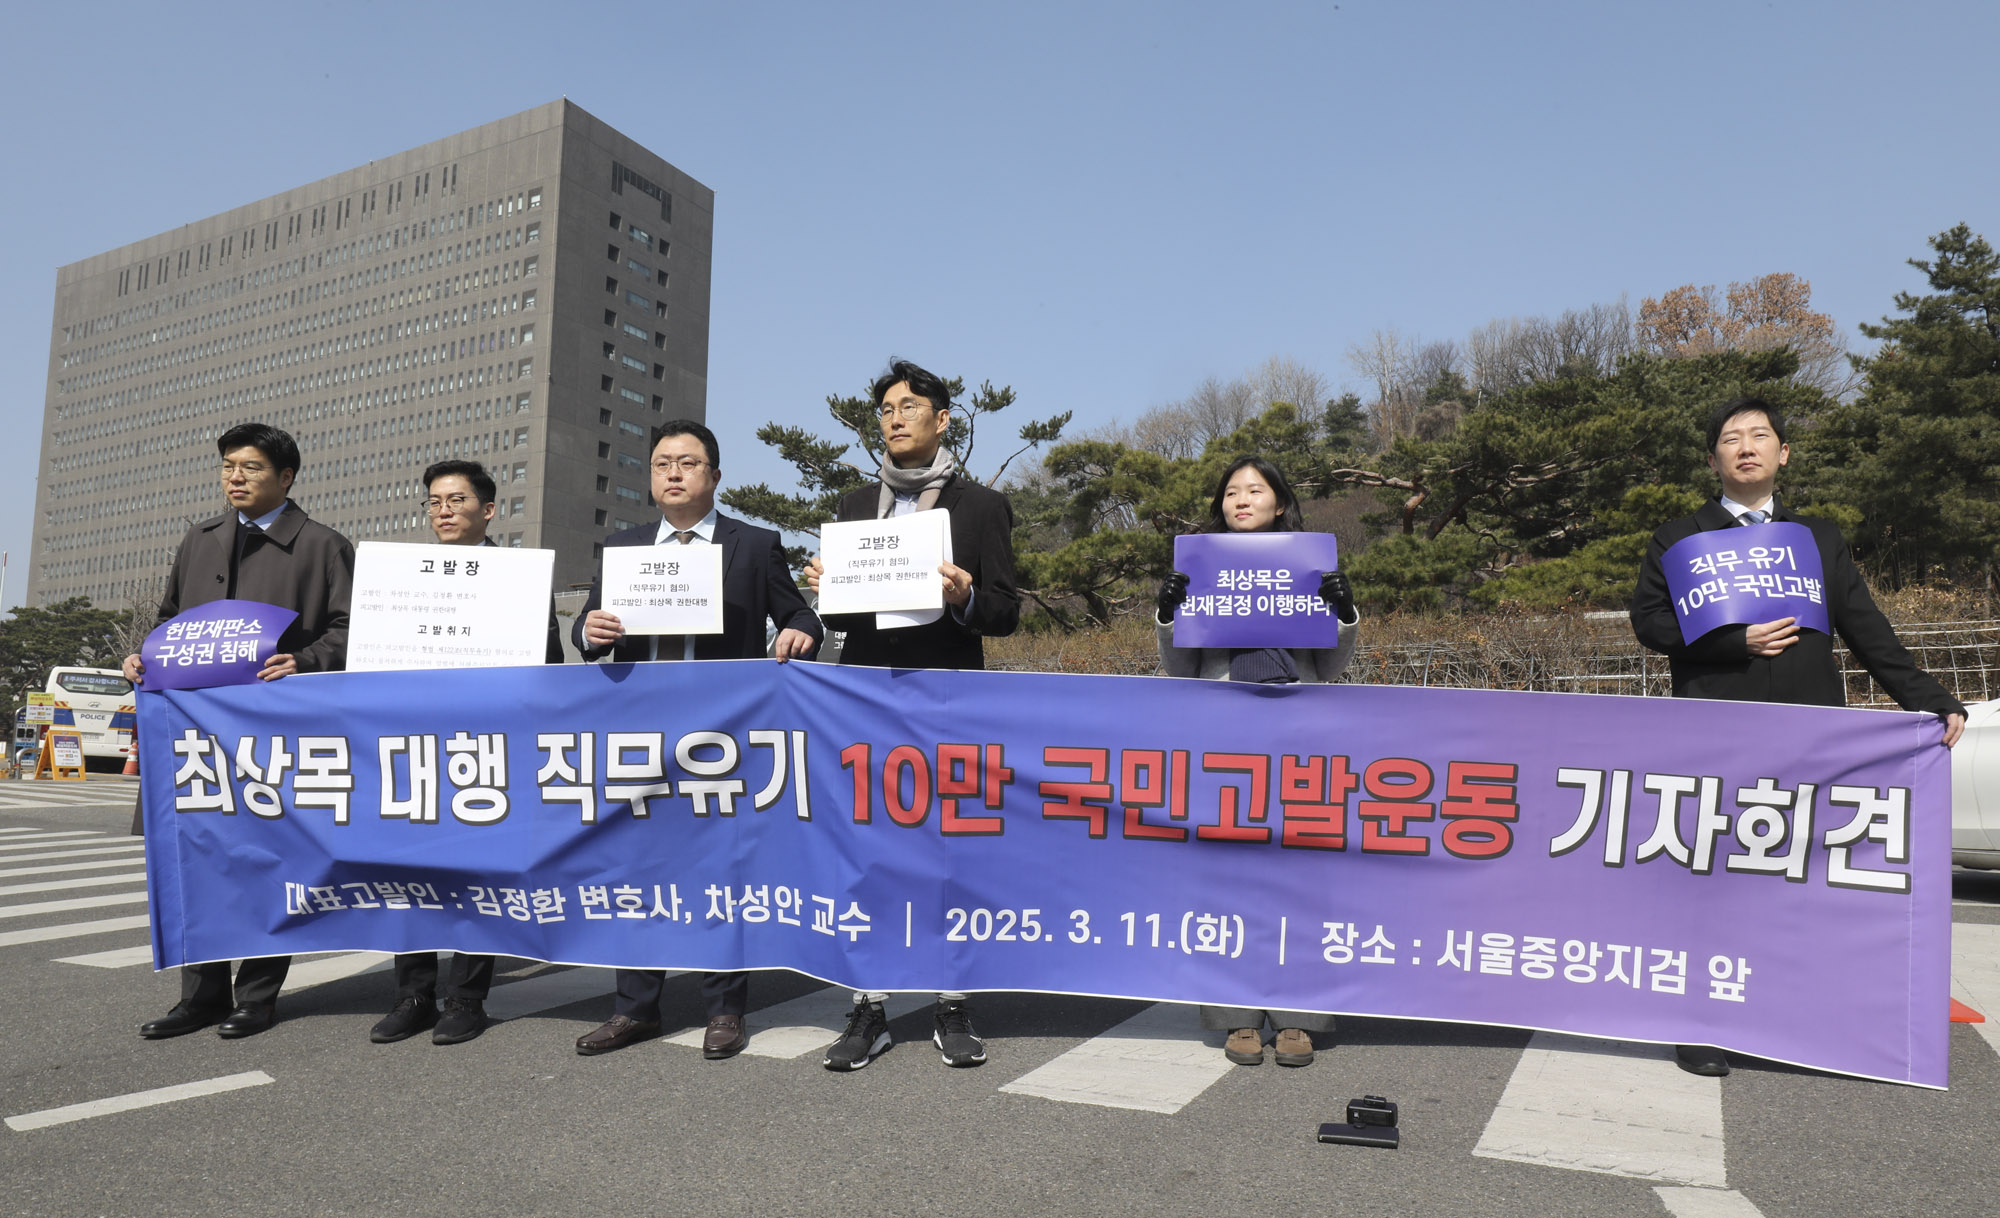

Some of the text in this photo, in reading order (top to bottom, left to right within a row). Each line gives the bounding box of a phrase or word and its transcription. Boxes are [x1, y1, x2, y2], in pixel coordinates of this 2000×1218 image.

[858, 535, 900, 550] 고발장
[639, 562, 680, 575] 고발장
[848, 557, 909, 568] (직무유기 혐의)
[1689, 546, 1796, 575] 직무 유기
[629, 584, 690, 593] (직무유기 혐의)
[831, 575, 861, 584] 피고발인
[868, 573, 891, 582] 최상목
[895, 572, 928, 581] 권한대행
[1216, 569, 1293, 591] 최상목은
[612, 598, 642, 607] 피고발인
[649, 598, 672, 607] 최상목
[676, 598, 708, 607] 권한대행
[1180, 594, 1332, 616] 헌재결정 이행하라
[1678, 574, 1822, 616] 10만 국민고발
[166, 618, 262, 641] 헌법재판소
[155, 640, 258, 667] 구성권 침해
[173, 727, 1912, 895] 최상목 대행 직무유기 10만 국민고발운동 기자회견
[285, 880, 444, 915] 대표고발인
[468, 884, 567, 924] 김정환
[578, 883, 692, 925] 변호사,
[704, 884, 803, 926] 차성안
[810, 895, 871, 942] 교수
[945, 908, 1054, 943] 2025.
[1068, 909, 1102, 944] 3.
[1120, 911, 1246, 959] 11.(화)
[1321, 921, 1396, 965] 장소
[1437, 927, 1687, 997] 서울중앙지검
[1708, 955, 1752, 1003] 앞
